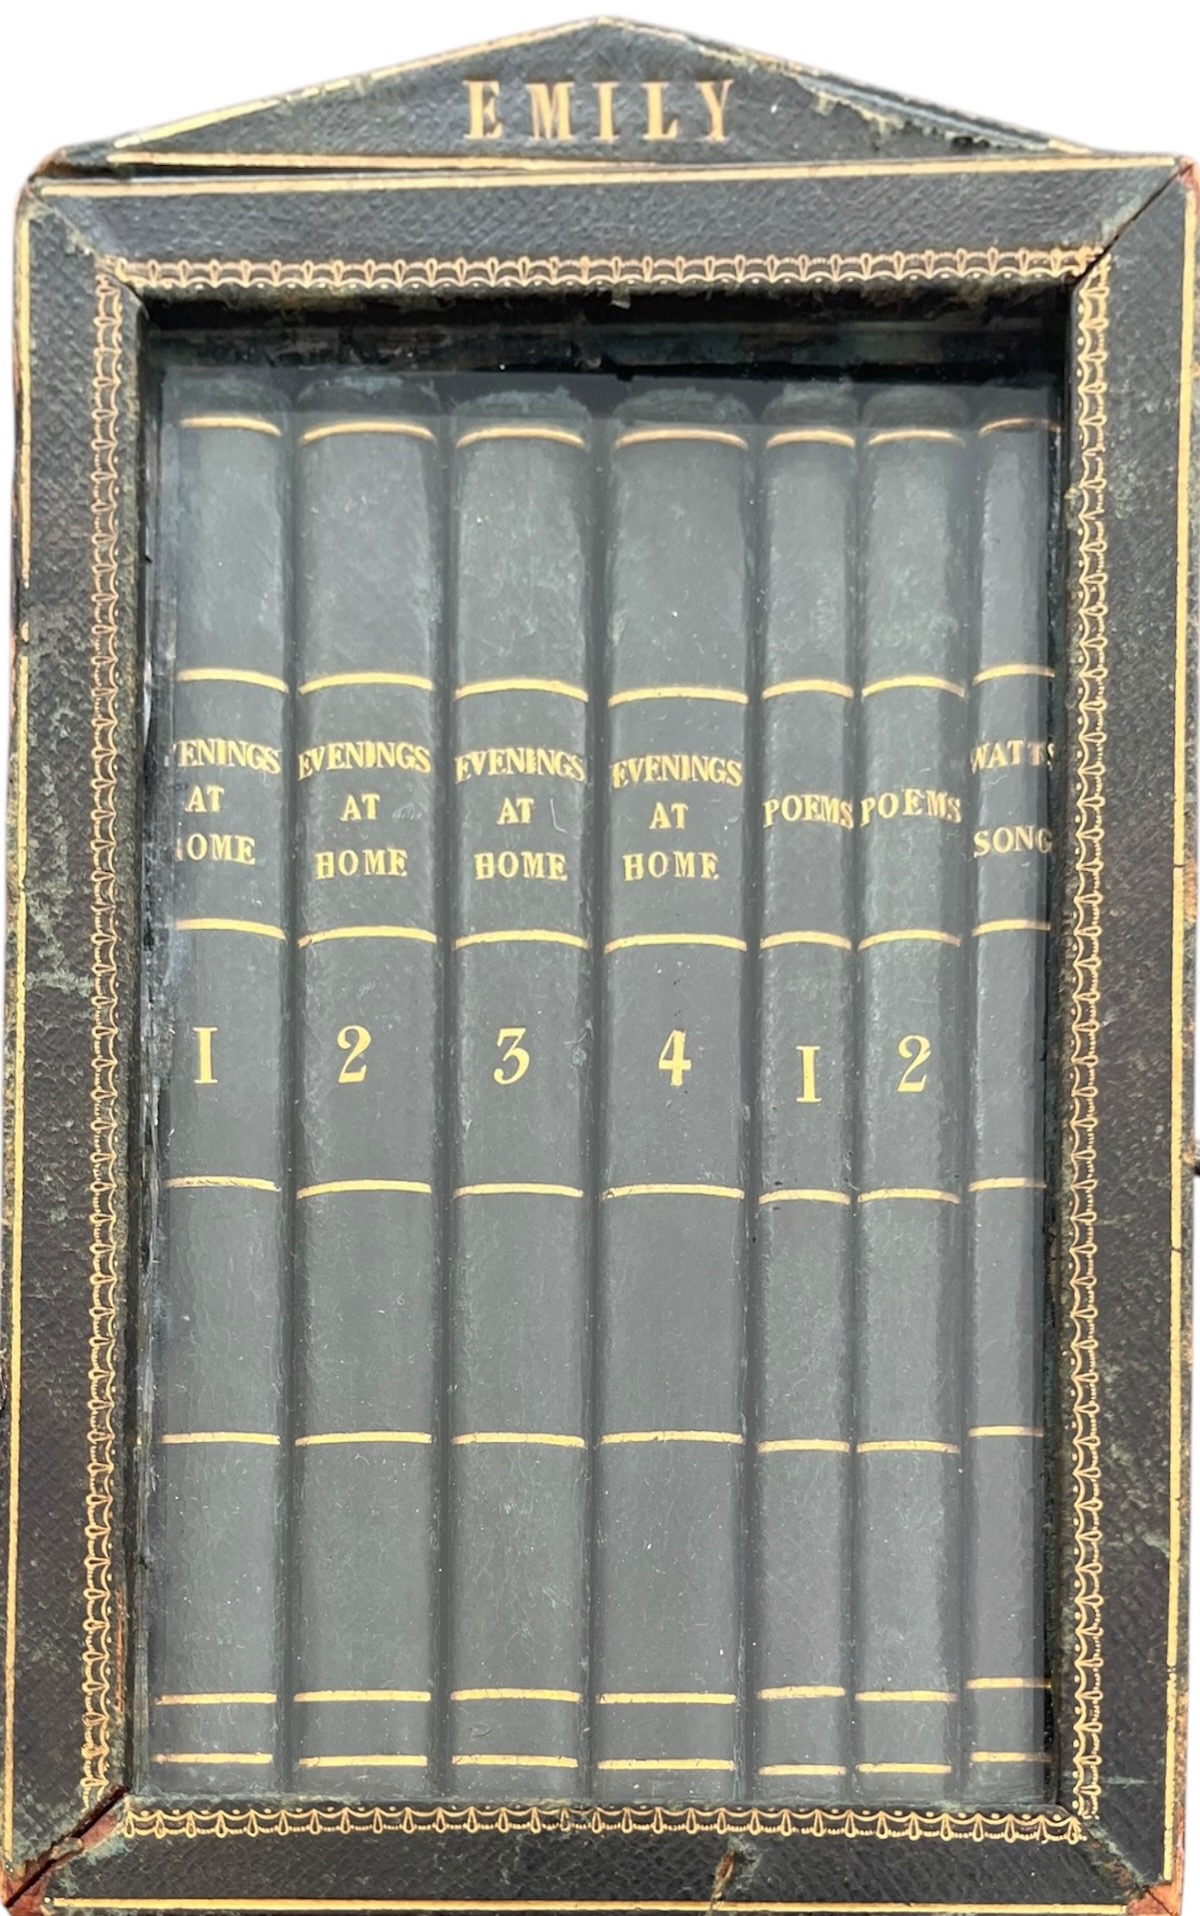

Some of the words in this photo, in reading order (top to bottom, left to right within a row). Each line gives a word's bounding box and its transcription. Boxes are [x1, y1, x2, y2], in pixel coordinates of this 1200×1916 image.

[463, 79, 734, 142] EMILY
[172, 738, 282, 775] ENINGS
[298, 740, 432, 781] EVENINGS
[456, 747, 587, 784] EVENINGS
[609, 753, 743, 790] EVENINGS
[184, 785, 225, 813] AT
[340, 794, 381, 822] AT
[497, 797, 535, 825] AT
[649, 802, 689, 830] AT
[762, 793, 855, 831] POEMS
[860, 787, 963, 827] POEMS
[315, 848, 408, 880] HOME
[474, 851, 569, 882] HOME
[623, 851, 720, 882] HOME
[337, 1025, 371, 1084] 2
[493, 1027, 531, 1085] 3
[657, 1029, 692, 1087] 4
[897, 1034, 932, 1093] 2
